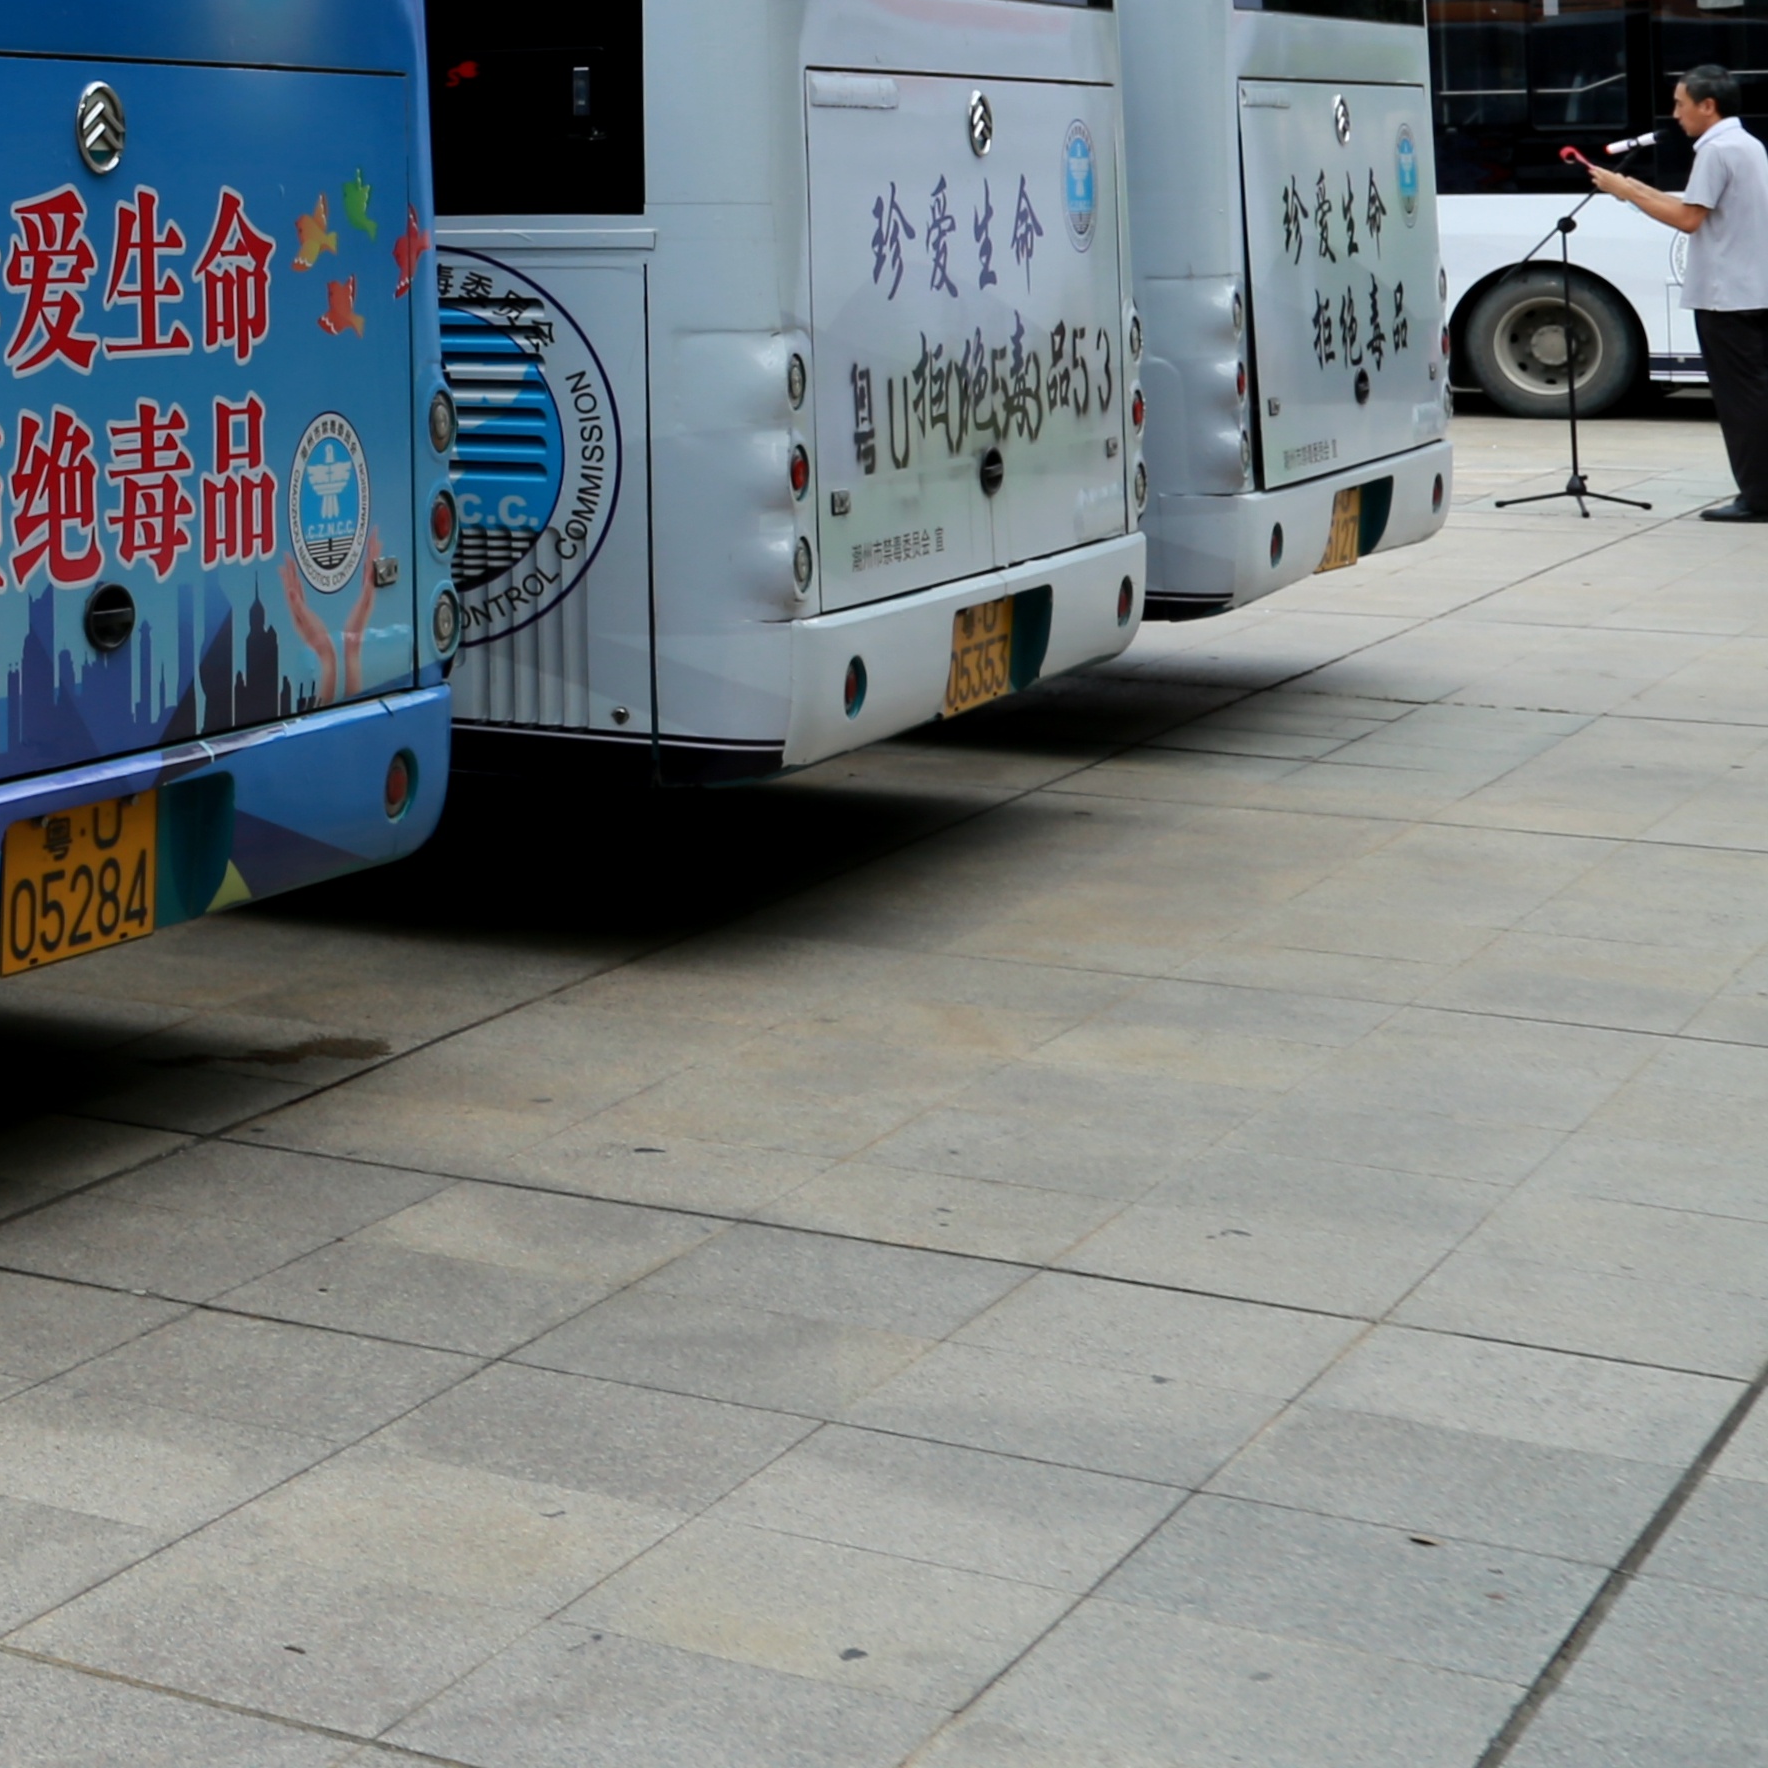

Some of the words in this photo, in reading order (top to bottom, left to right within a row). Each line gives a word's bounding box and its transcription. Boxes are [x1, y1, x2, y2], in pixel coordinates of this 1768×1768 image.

[871, 173, 1044, 301] 珍爱生命
[1282, 167, 1387, 266] 珍爱生命
[912, 309, 1070, 439] 拒绝毒品
[1312, 272, 1408, 372] 拒绝毒品
[554, 369, 605, 561] COMMISSION
[459, 563, 560, 630] ONTROL
[947, 634, 1009, 709] 05353
[9, 848, 148, 961] 05284
